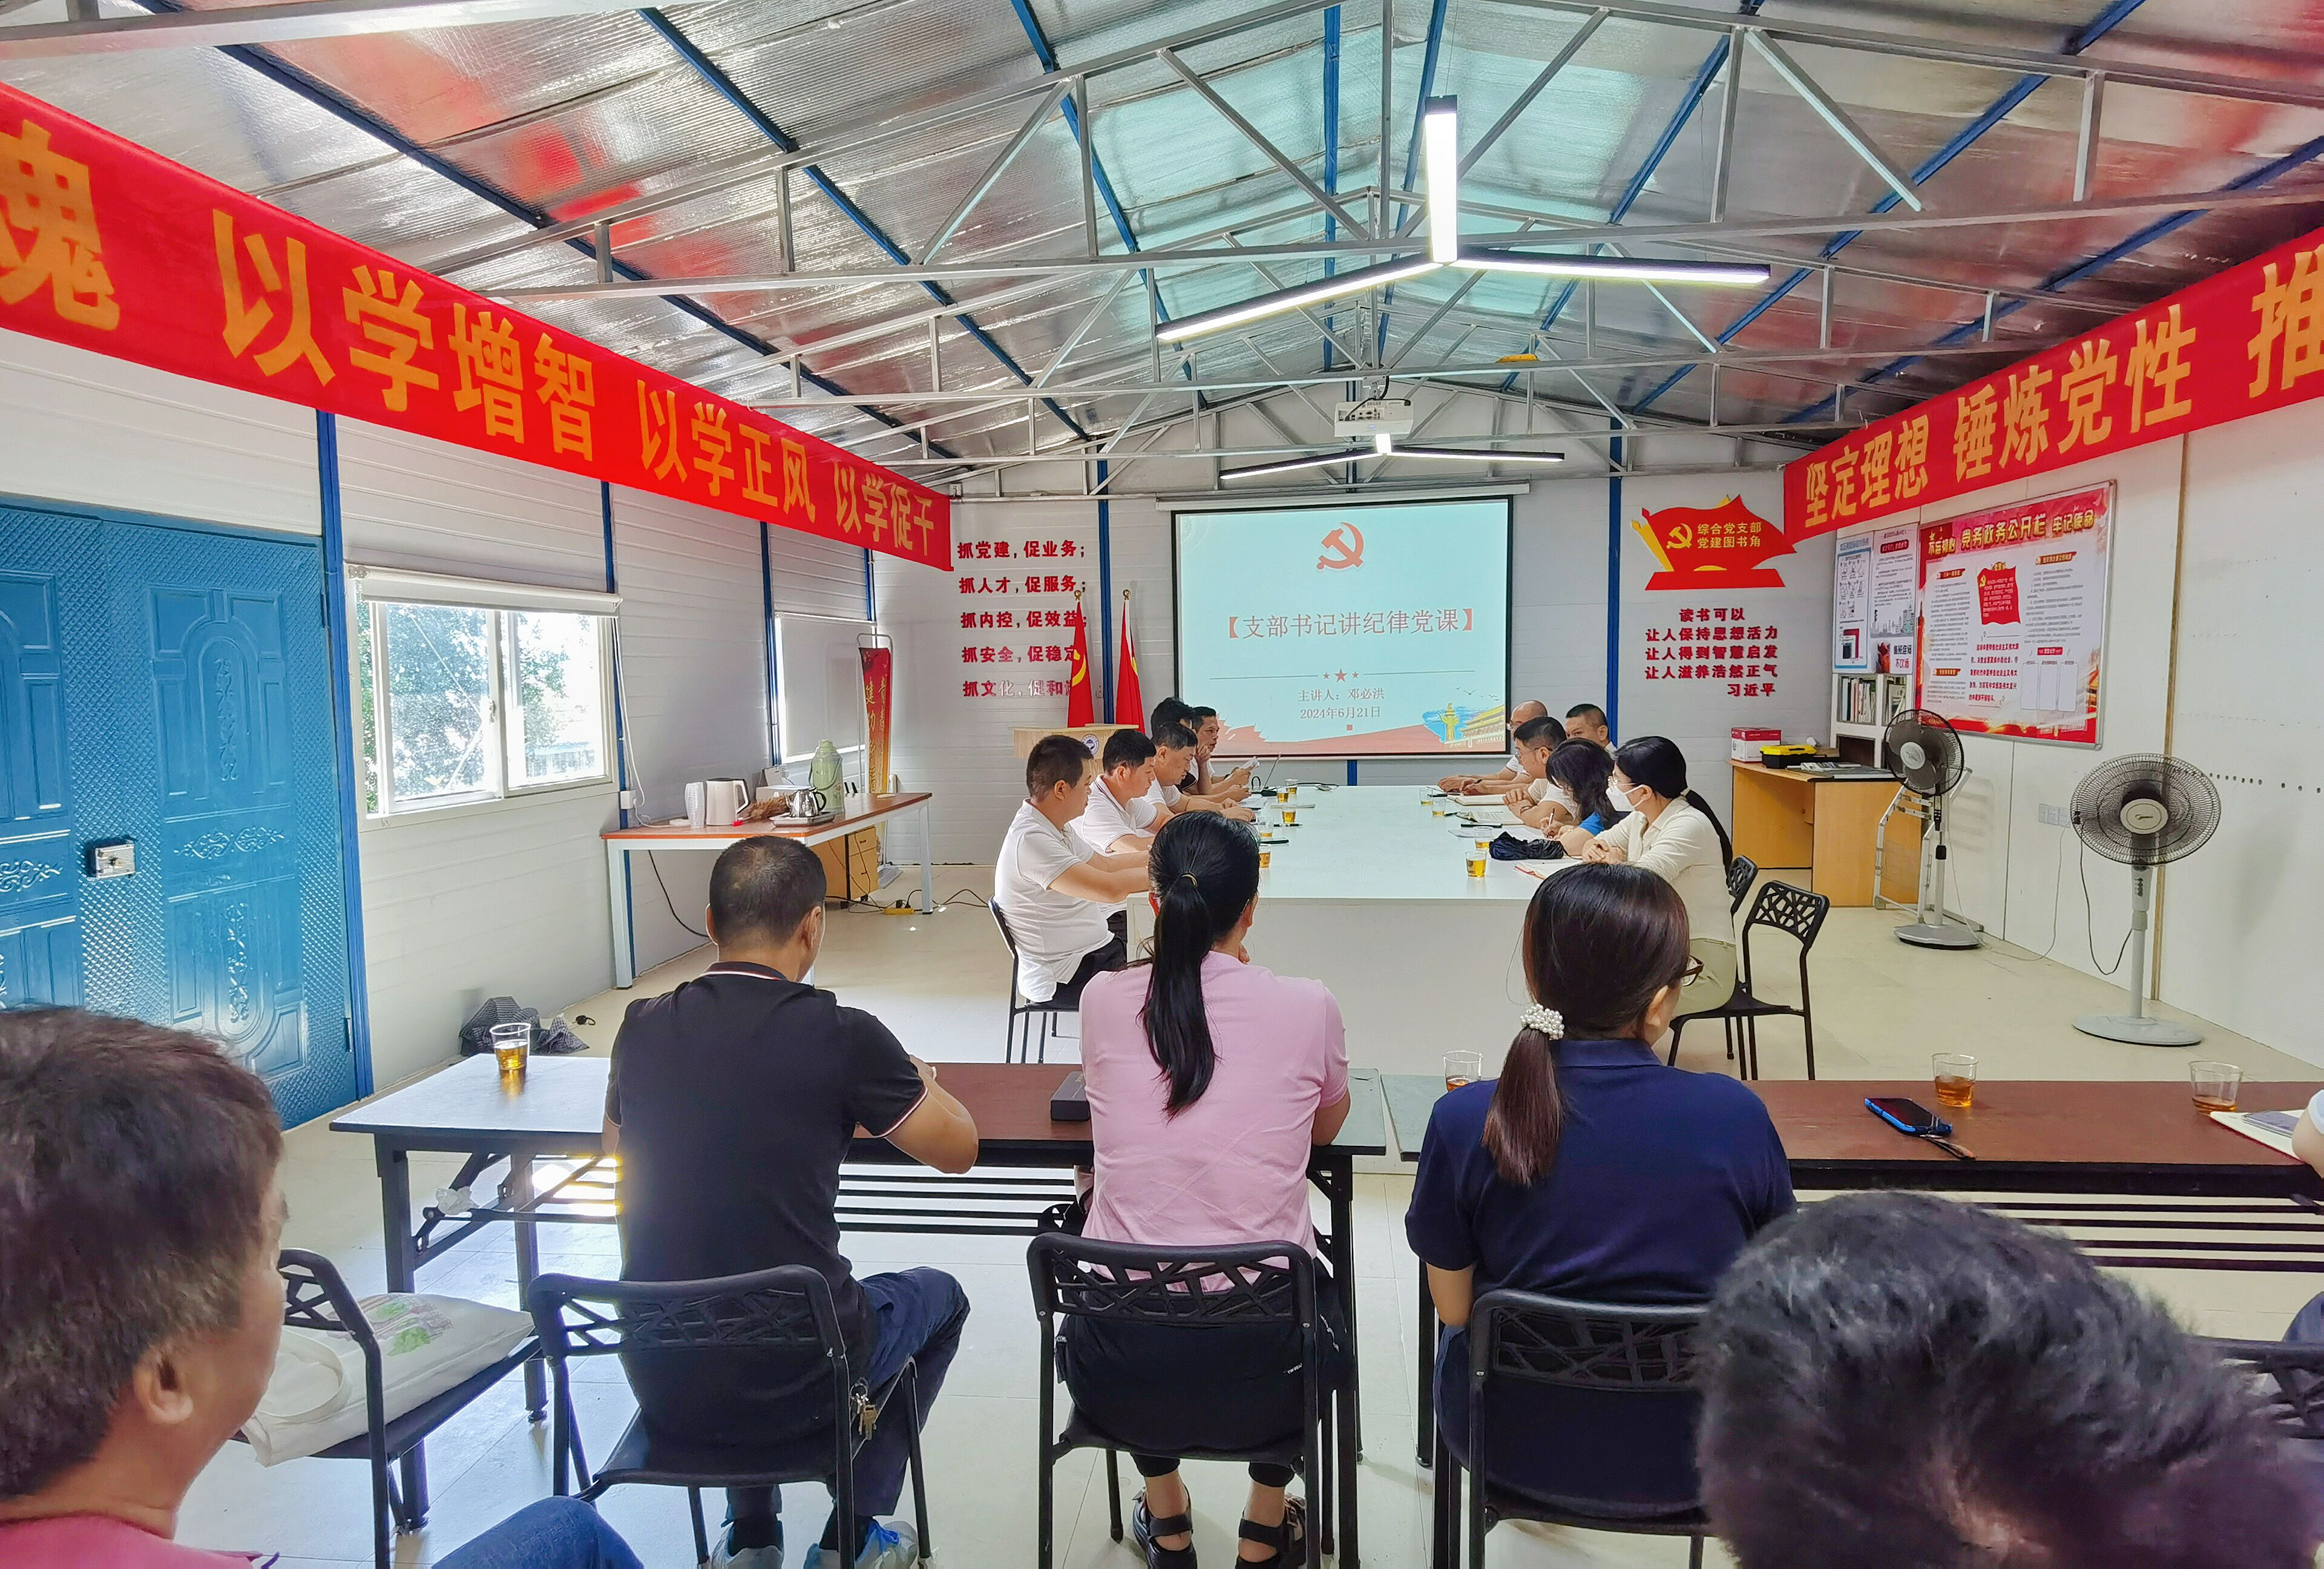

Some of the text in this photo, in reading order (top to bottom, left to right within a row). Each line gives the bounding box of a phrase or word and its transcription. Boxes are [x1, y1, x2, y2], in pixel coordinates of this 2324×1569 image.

[212, 208, 595, 462] 以学增智
[637, 379, 815, 523] 以学正风
[833, 461, 934, 556] 以学促干
[1805, 414, 1929, 527] 坚定理想
[1953, 304, 2196, 482] 锤炼党性
[1697, 521, 1762, 535] 综合党支部
[1961, 513, 2046, 550] 党务政务公开栏
[2052, 510, 2095, 534] 牢记使命
[1697, 536, 1761, 549] 党建图书角
[1679, 607, 1745, 622] 读书可以
[1229, 608, 1474, 639] 【支部书记讲纪律党课】
[1645, 626, 1778, 642] 让人保持思想活力
[1645, 645, 1778, 660] 让人得到智慧启发
[1644, 663, 1778, 679] 让人滋养浩然正气
[963, 680, 1070, 697] 抓文化，促和
[1727, 683, 1776, 697] 习近平
[1299, 706, 1381, 719] 2024年6月21日
